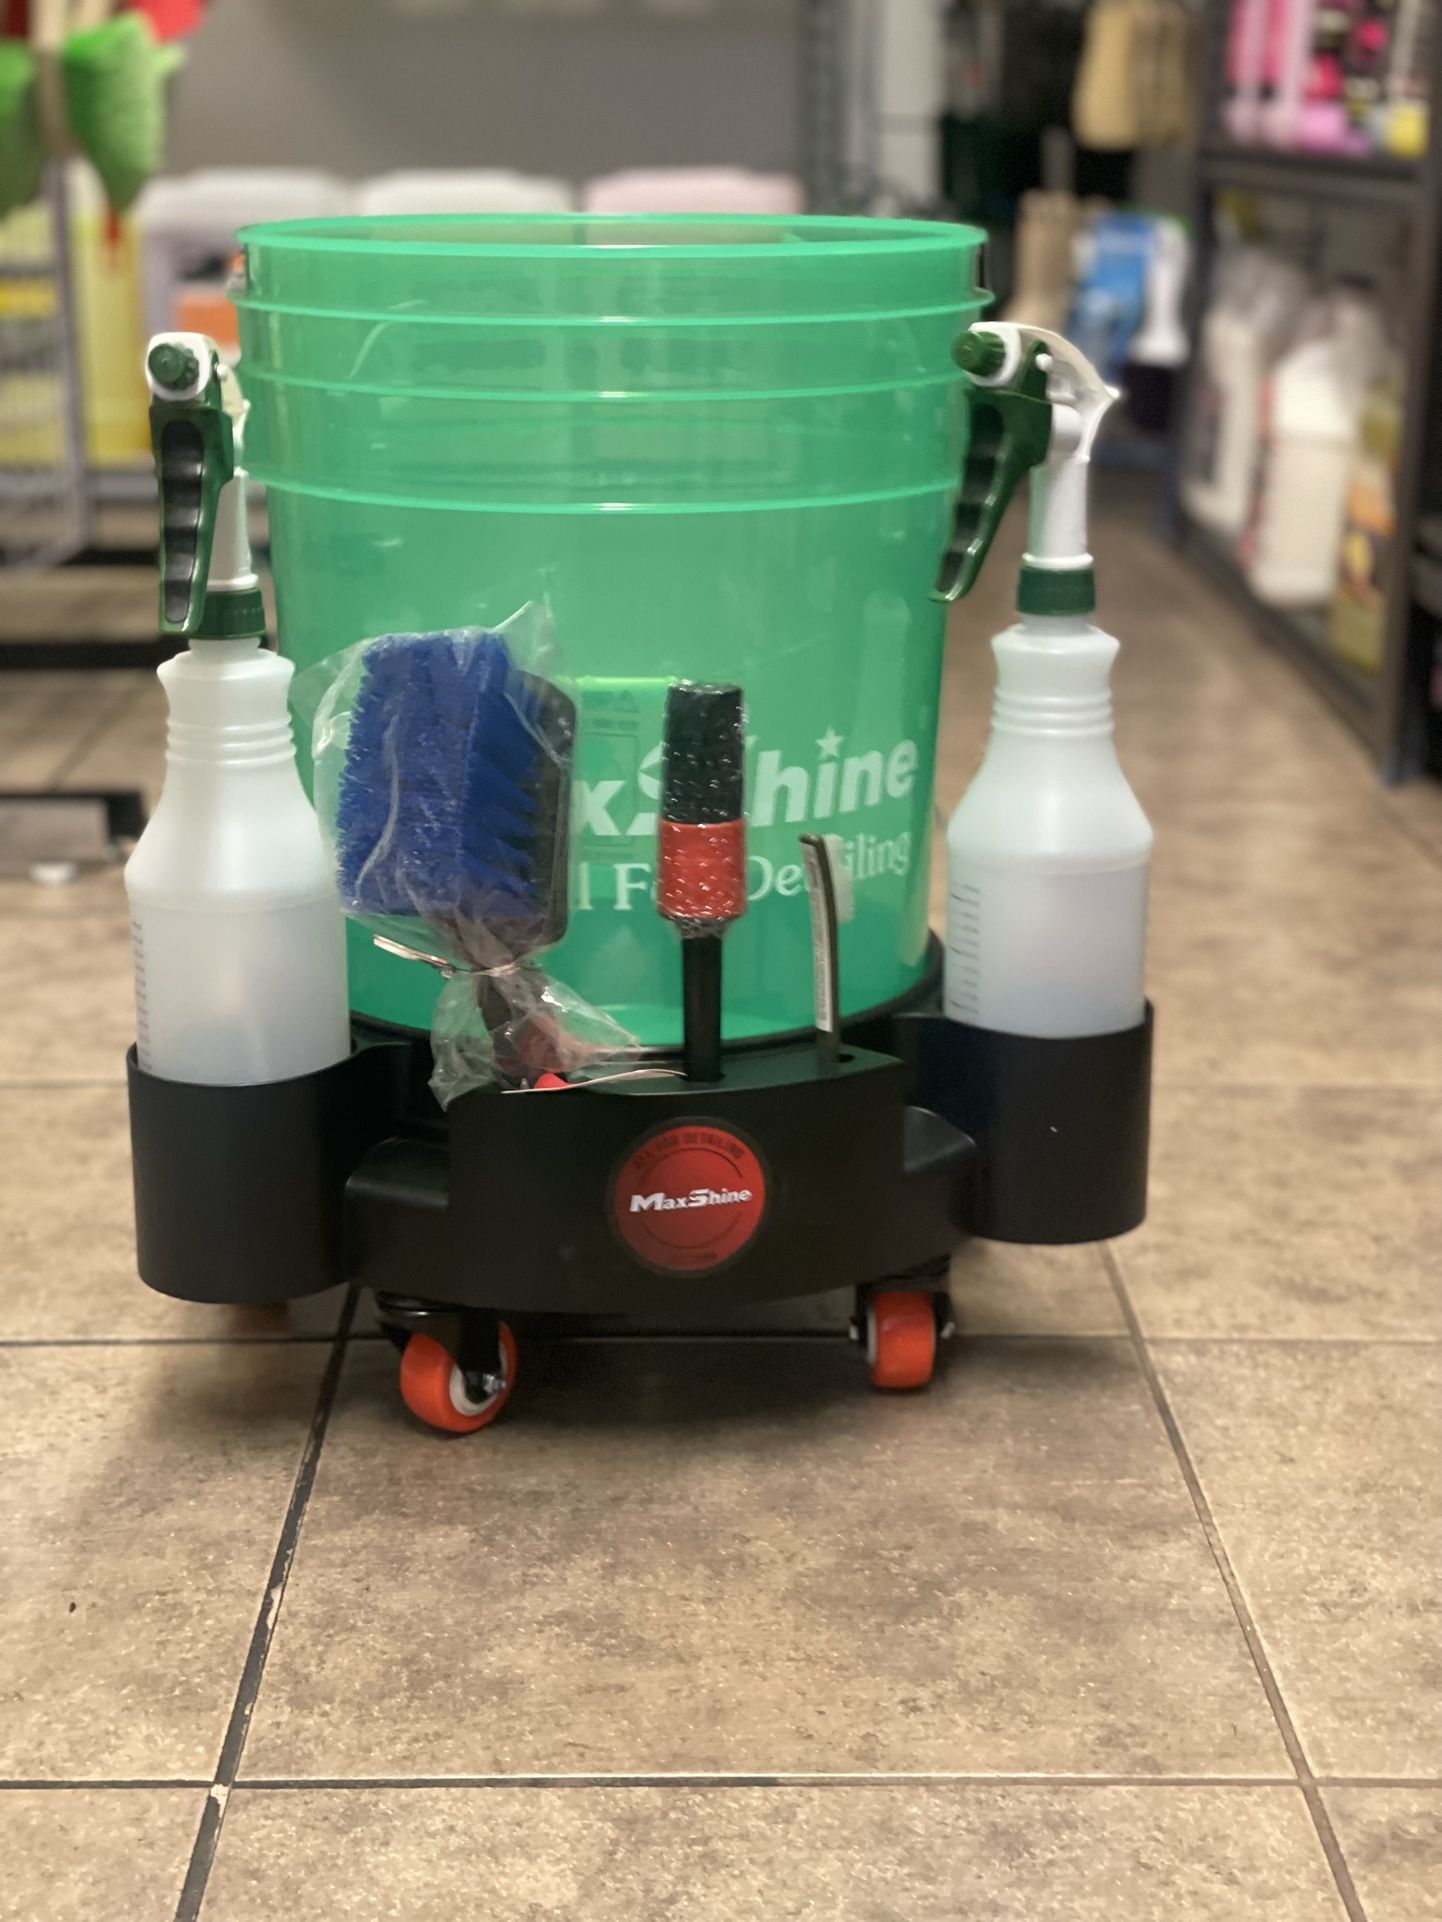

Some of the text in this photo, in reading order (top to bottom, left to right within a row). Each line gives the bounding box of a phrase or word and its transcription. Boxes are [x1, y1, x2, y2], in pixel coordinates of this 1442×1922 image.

[572, 727, 920, 836] xhine
[747, 832, 912, 901] Deiling
[630, 1188, 752, 1212] MaxShine
